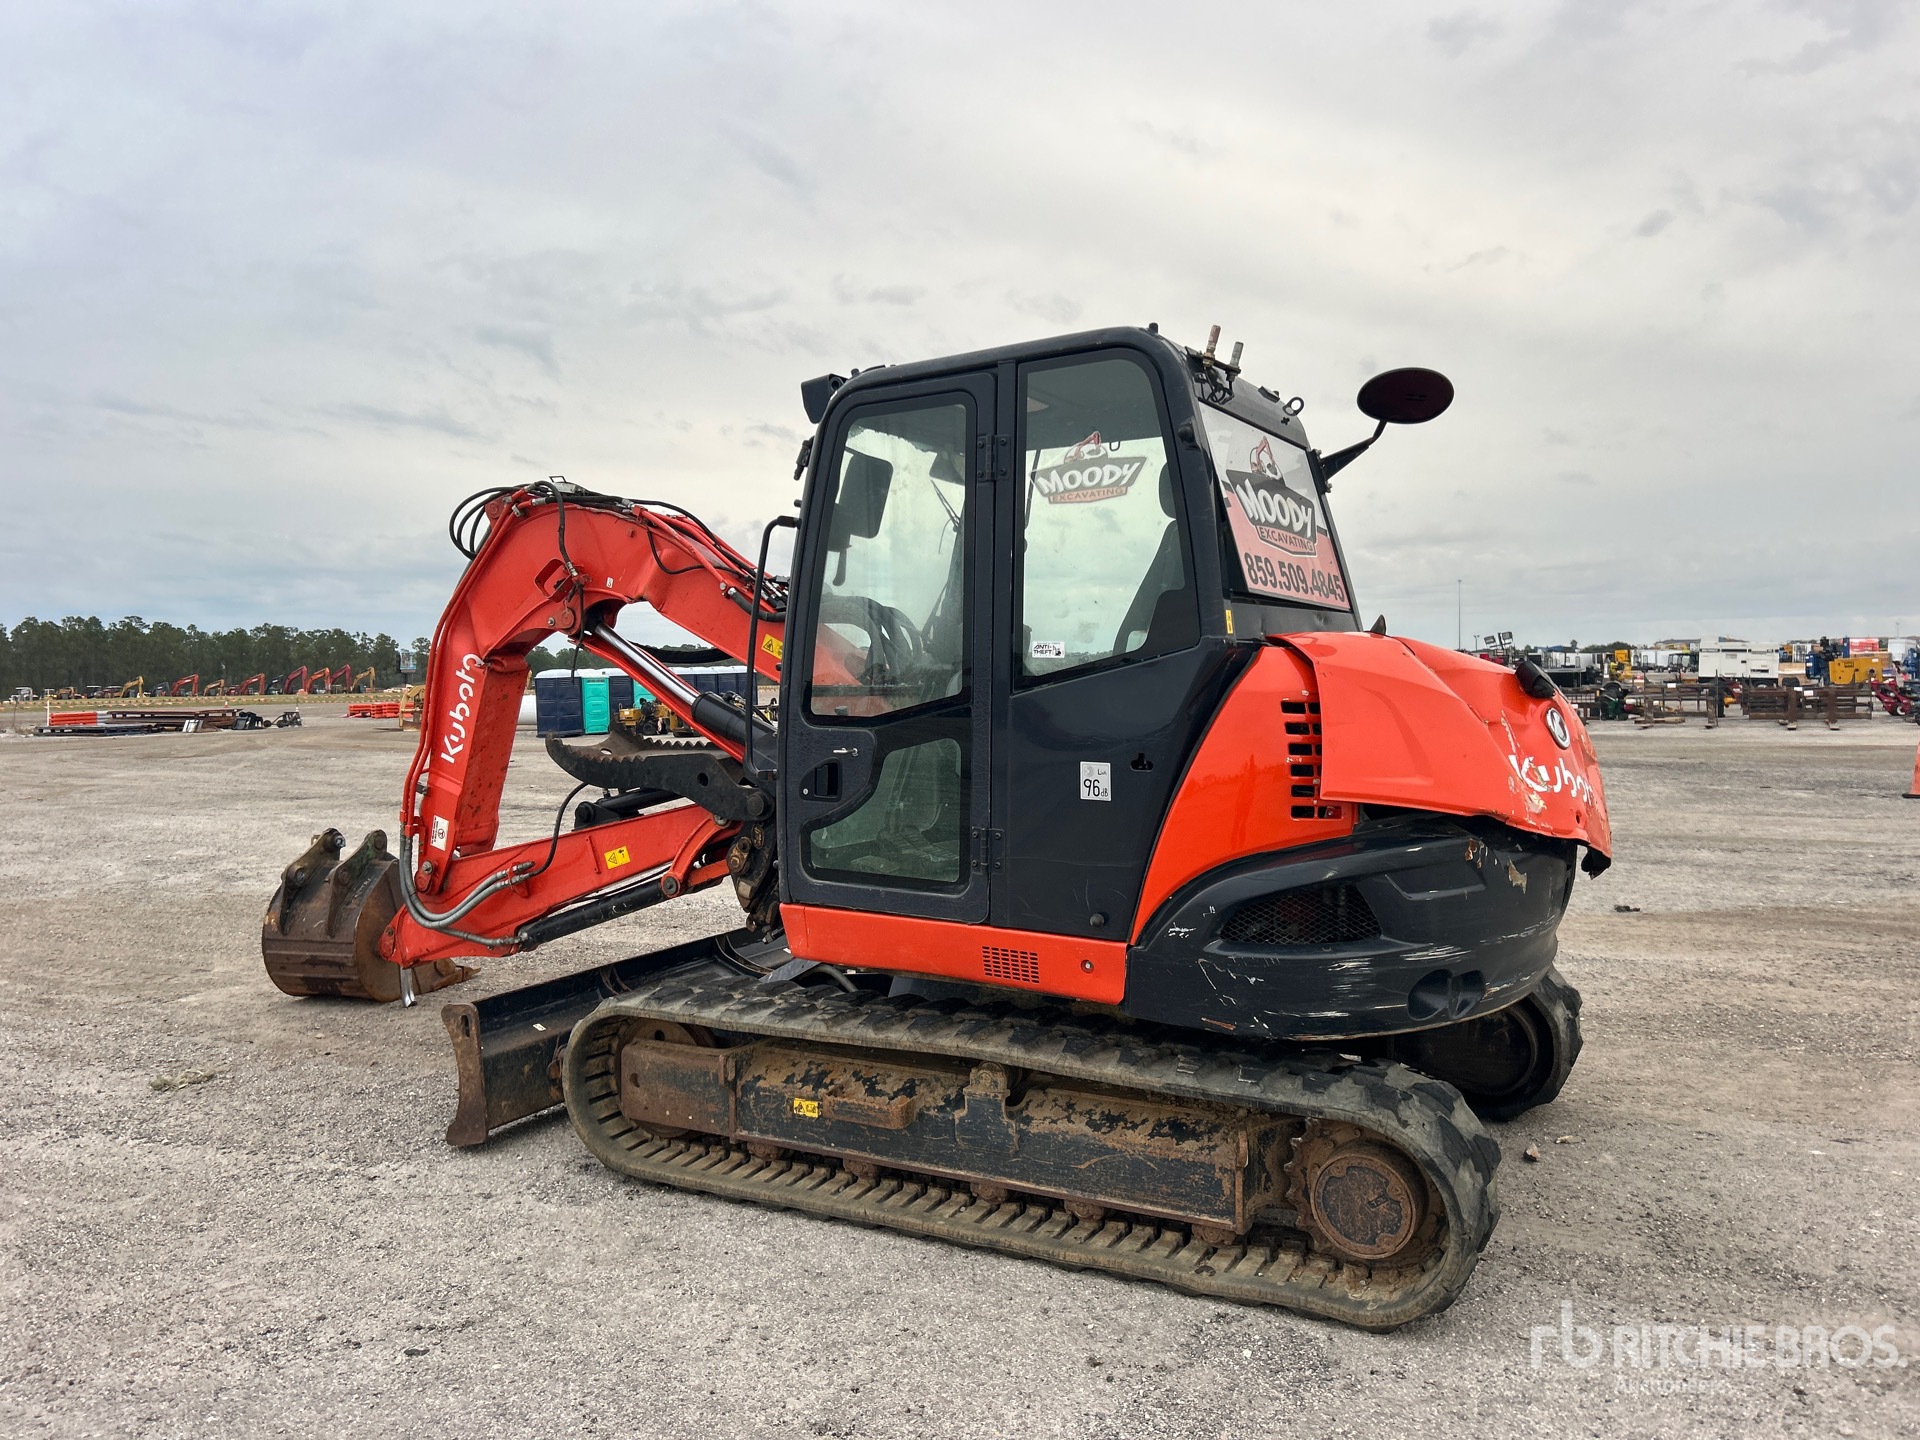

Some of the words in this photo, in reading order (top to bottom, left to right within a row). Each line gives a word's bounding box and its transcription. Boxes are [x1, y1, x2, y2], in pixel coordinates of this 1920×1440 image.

[1037, 462, 1140, 494] MOODY
[1052, 488, 1123, 501] EXCAVATING
[1236, 479, 1312, 539] MOODY
[1259, 527, 1314, 552] EXCAVATING
[1243, 552, 1345, 603] 859.509.4845
[1083, 778, 1101, 797] 96
[1100, 787, 1109, 797] dB
